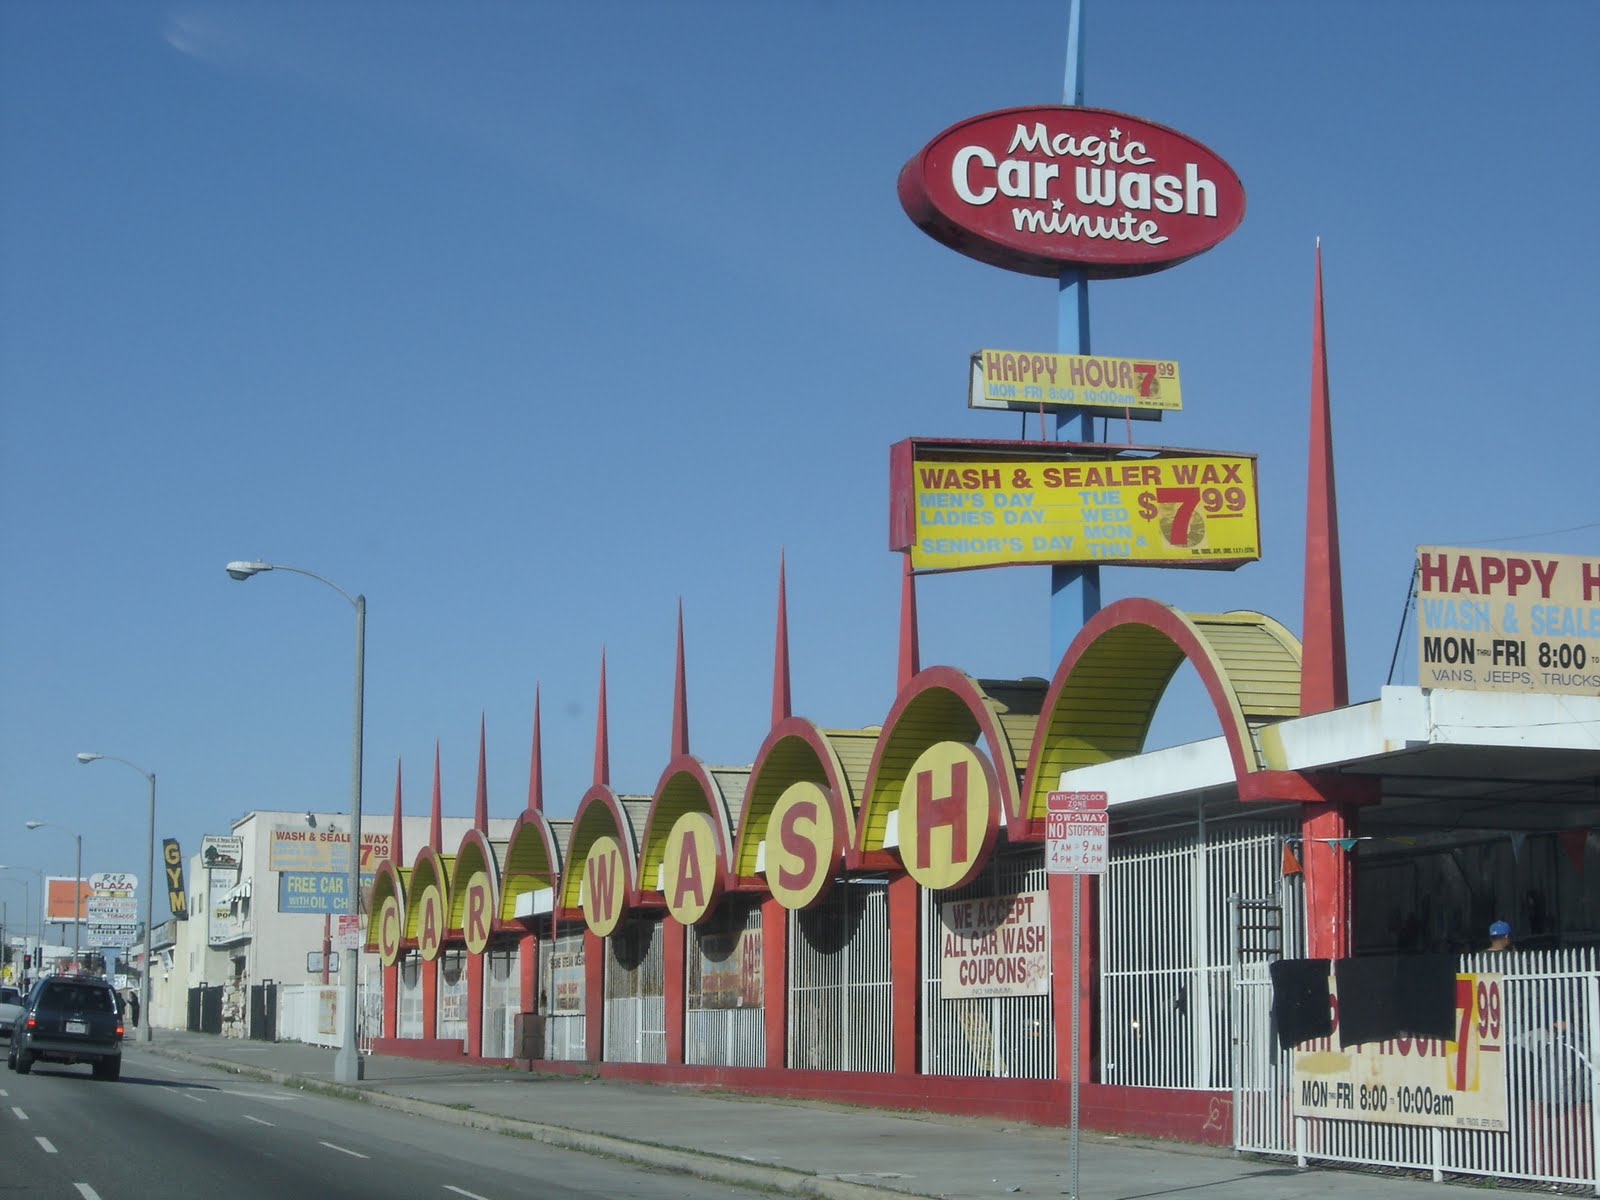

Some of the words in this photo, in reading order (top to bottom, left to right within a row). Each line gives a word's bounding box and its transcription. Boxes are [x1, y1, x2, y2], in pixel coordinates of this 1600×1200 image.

[1006, 122, 1156, 165] Magic
[951, 145, 1060, 206] Car
[1075, 162, 1218, 217] wash
[1011, 198, 1169, 245] minute
[986, 351, 1057, 384] HAPPY
[1069, 357, 1134, 389] HOUR
[919, 468, 1002, 490] WASH
[1011, 468, 1033, 489] &
[1042, 465, 1162, 488] SEALER
[1171, 463, 1244, 485] WAX
[919, 492, 985, 509] MEN'S
[993, 492, 1036, 508] DAY
[1077, 490, 1122, 505] TUE
[919, 509, 995, 526] LADIES
[1004, 509, 1046, 525] DAY
[1080, 508, 1129, 523] WED
[1084, 524, 1132, 540] MON
[921, 537, 1024, 555] SENIOR'S
[1031, 535, 1075, 552] DAY
[1085, 542, 1132, 558] THU
[1421, 553, 1559, 599] HAPPY
[1422, 597, 1491, 633] WASH
[1502, 602, 1519, 635] &
[1423, 636, 1475, 665] MON
[1492, 639, 1526, 667] FRI
[1538, 642, 1586, 670] 8:00
[1431, 669, 1476, 684] VANS,
[1483, 670, 1534, 686] JEEPS,
[1067, 800, 1088, 808] ZONE
[1049, 813, 1105, 822] TOW-AWAY
[275, 831, 306, 841] WASH
[308, 832, 317, 842] &
[364, 834, 389, 844] WAX
[1048, 823, 1065, 838] NO
[1067, 825, 1106, 837] STOPPING
[1051, 840, 1059, 852] 7
[1082, 840, 1089, 852] 9
[1091, 844, 1103, 852] AM
[1051, 852, 1058, 863] 4
[1082, 853, 1089, 864] 6
[1091, 856, 1103, 864] PM
[94, 882, 134, 890] PLAZA
[164, 843, 186, 912] GYM
[287, 876, 317, 893] FREE
[320, 876, 343, 894] CAR
[288, 897, 310, 905] WITH
[310, 897, 328, 909] OIL
[953, 903, 972, 930] WE
[977, 896, 1034, 928] ACCEPT
[944, 932, 967, 958] ALL
[970, 928, 998, 957] CAR
[1002, 925, 1045, 955] WASH
[959, 956, 1027, 986] COUPONS
[1301, 1080, 1328, 1108] MON
[1336, 1082, 1354, 1109] FRI
[1359, 1084, 1387, 1111] 8:00
[1397, 1086, 1454, 1116] 10:00am
